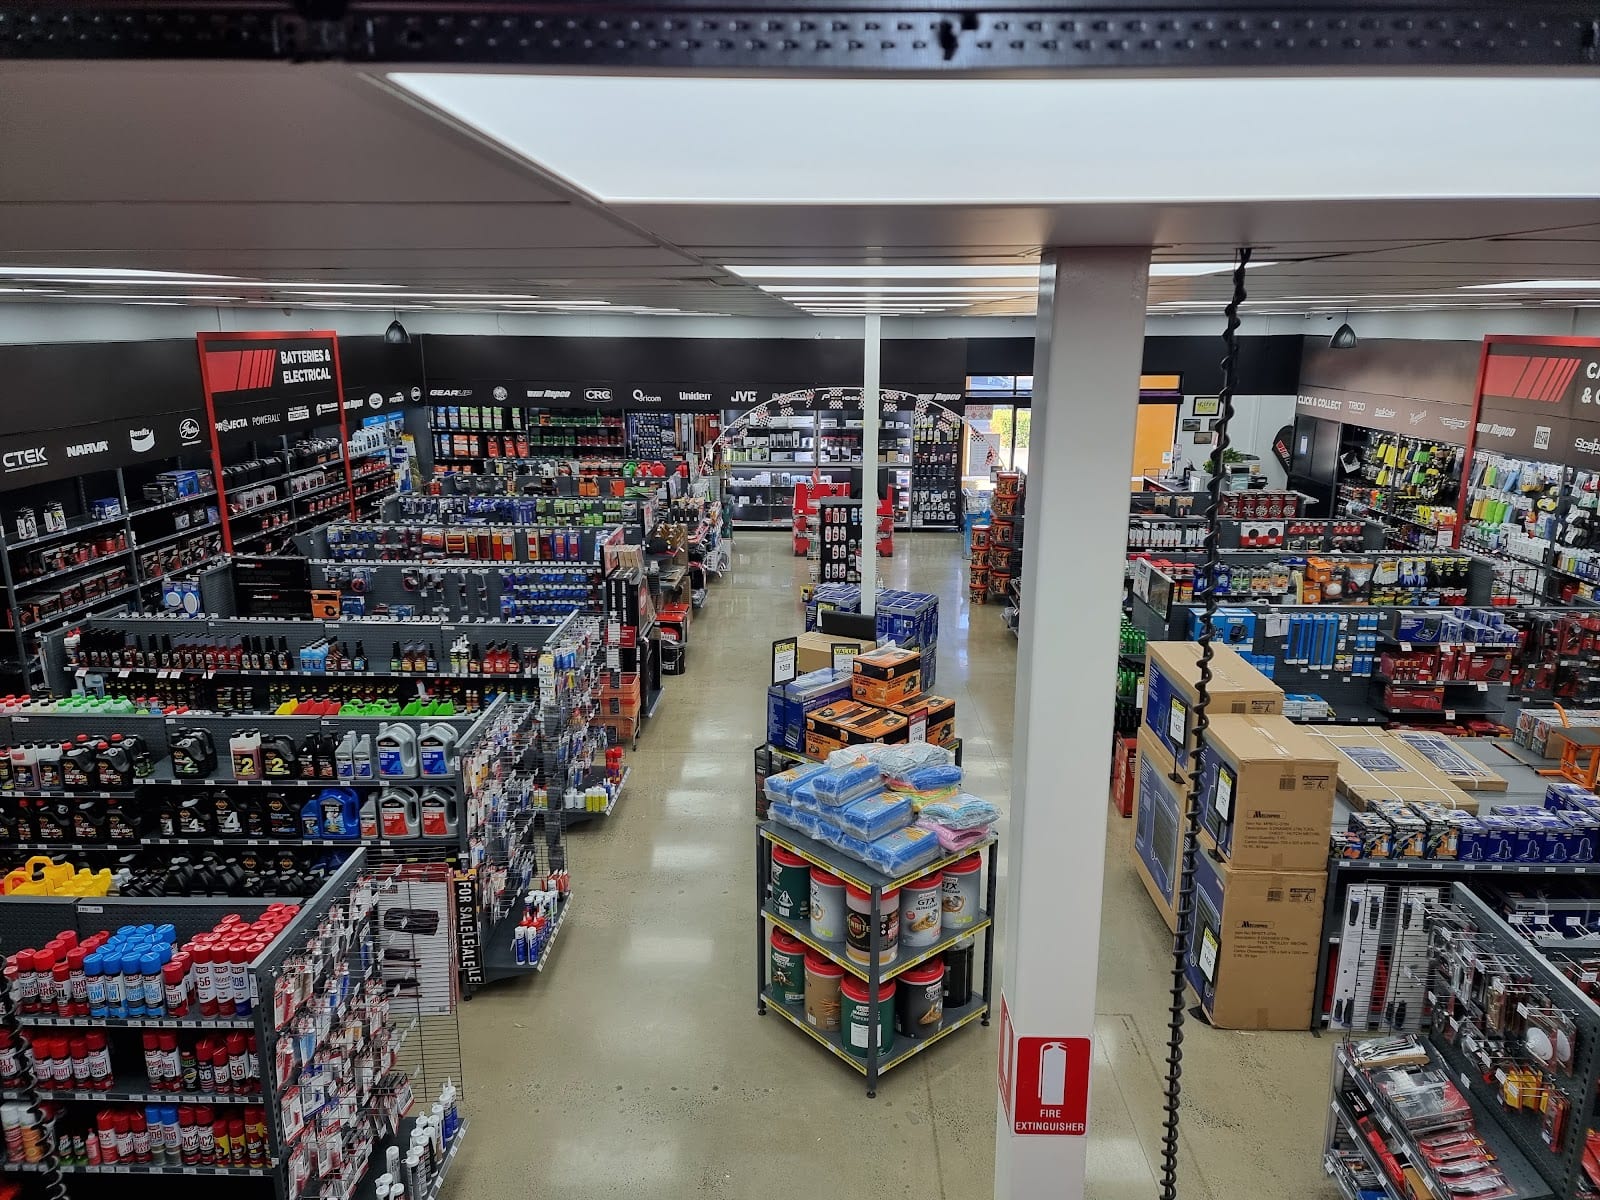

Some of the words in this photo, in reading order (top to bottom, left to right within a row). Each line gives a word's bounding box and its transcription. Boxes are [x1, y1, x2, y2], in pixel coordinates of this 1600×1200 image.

[281, 349, 324, 365] BATTERIES
[324, 349, 331, 362] &
[283, 368, 331, 384] ELECTRICAL
[430, 389, 472, 397] GEARUP
[585, 390, 611, 400] CRC
[679, 391, 712, 401] Uniden
[731, 391, 757, 402] JVC
[1581, 387, 1592, 403] &
[1298, 395, 1312, 406] CLICK
[1318, 398, 1342, 410] COLLECT
[215, 418, 248, 433] PROJECTA
[252, 413, 280, 426] POWERALL
[130, 428, 149, 438] Bendix
[66, 441, 108, 457] NARVA
[3, 447, 48, 468] CTEK
[243, 757, 254, 774] 2
[272, 758, 285, 772] 2
[189, 818, 199, 829] 4
[224, 811, 241, 828] 4
[458, 882, 472, 903] FOR
[918, 898, 935, 906] GTX
[460, 907, 473, 932] SALE
[199, 976, 210, 986] 56
[217, 1072, 226, 1080] 56
[231, 1065, 243, 1076] 56
[1040, 1109, 1061, 1118] FIRE
[1015, 1121, 1084, 1132] EXTINGUISHER
